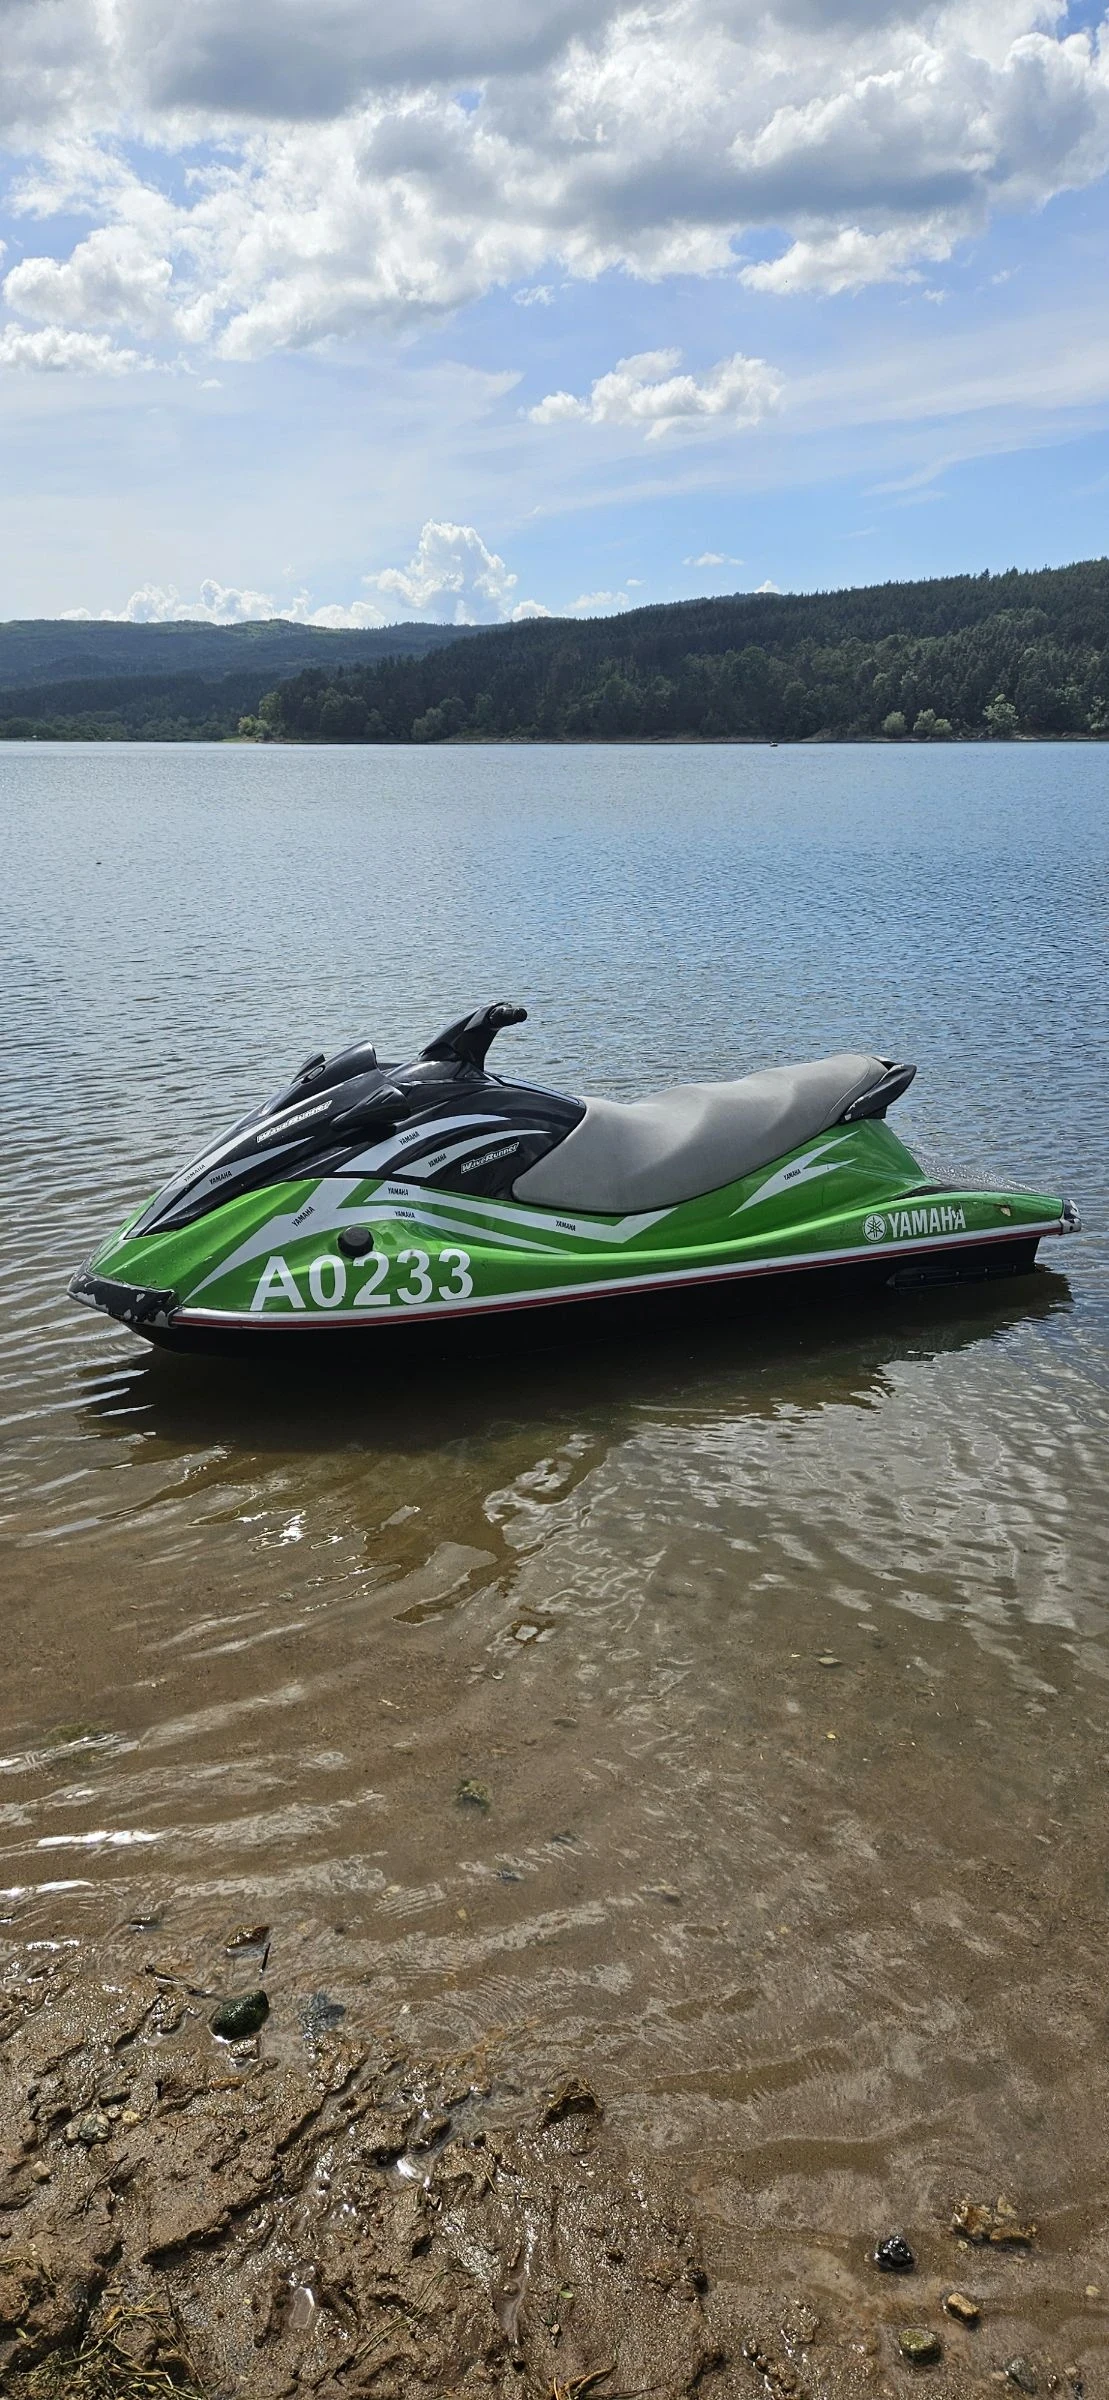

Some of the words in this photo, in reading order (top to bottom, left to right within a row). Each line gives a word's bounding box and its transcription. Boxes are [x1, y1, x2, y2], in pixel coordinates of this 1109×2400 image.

[398, 1131, 420, 1147] YAMAHA
[428, 1153, 447, 1168] YAMAHA
[461, 1142, 520, 1174] WaveRunner
[183, 1164, 206, 1182] YAMAHA
[209, 1170, 233, 1185] YAMAHA
[783, 1168, 802, 1181] YAMAHA
[387, 1187, 409, 1196] YAMAHA
[291, 1206, 316, 1227] YAMAHA
[394, 1210, 416, 1219] YAMAHA
[887, 1206, 966, 1238] YAMAHA
[555, 1220, 576, 1232] YAMAHA
[249, 1248, 474, 1311] A0233
